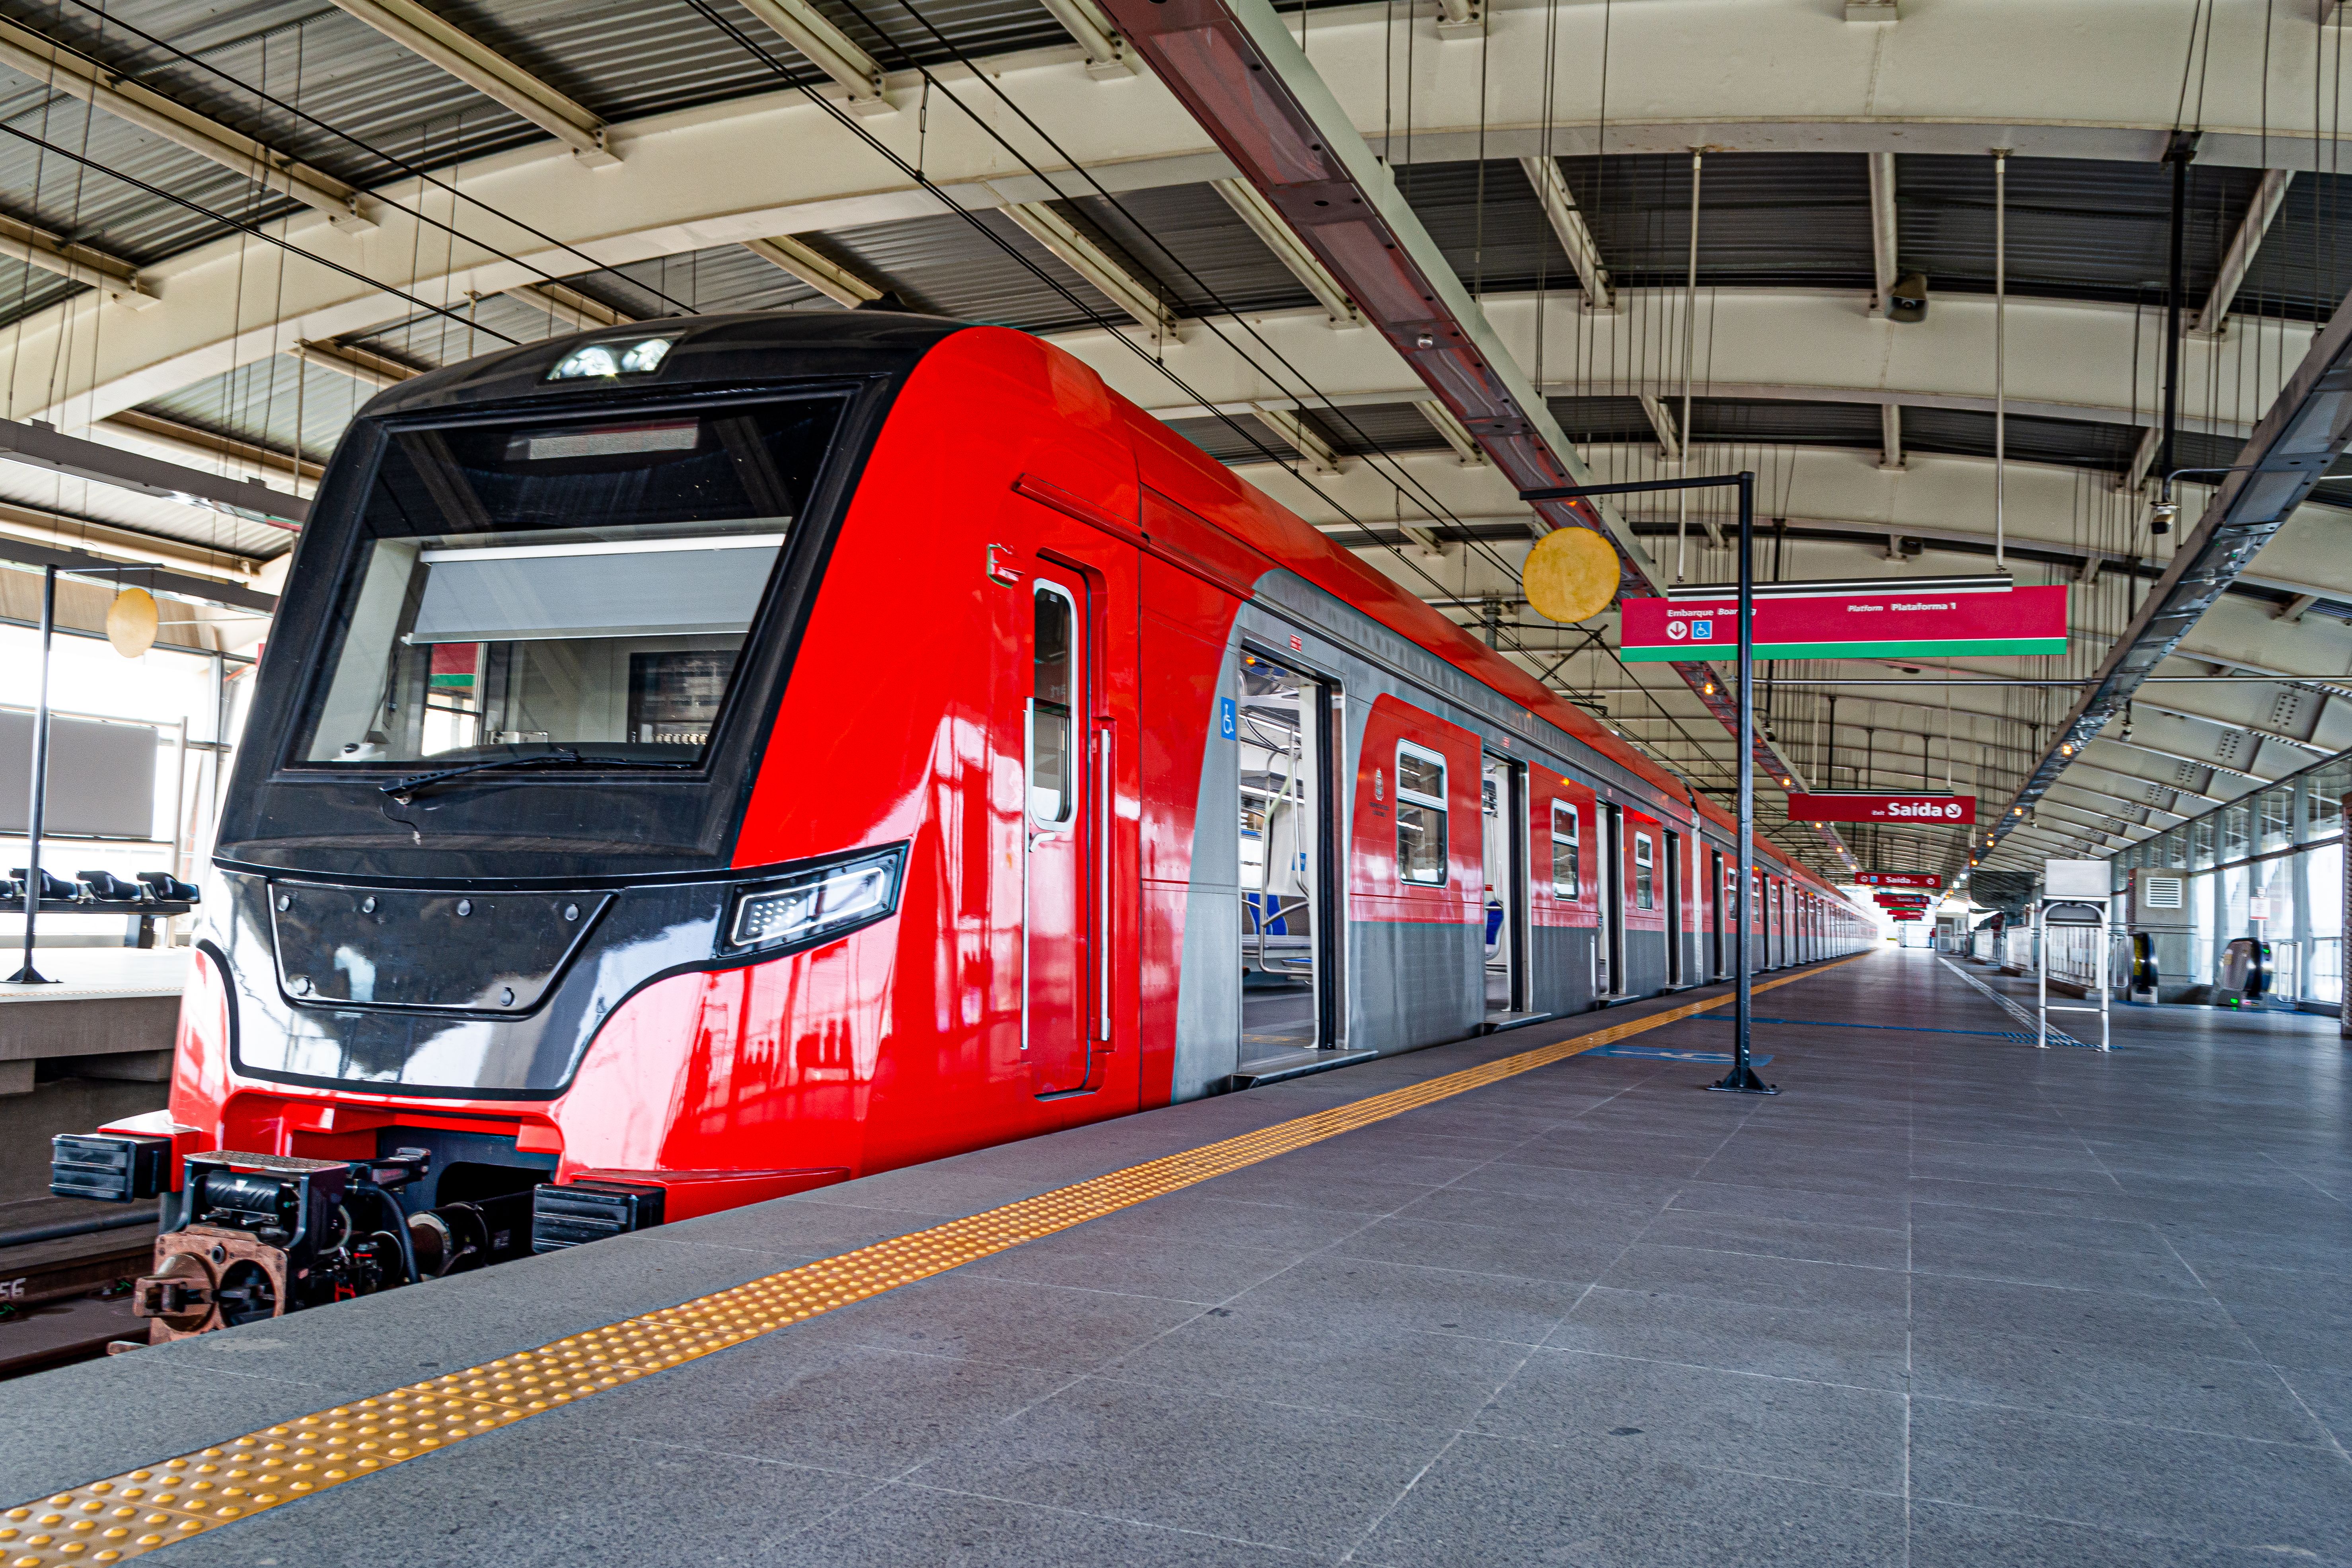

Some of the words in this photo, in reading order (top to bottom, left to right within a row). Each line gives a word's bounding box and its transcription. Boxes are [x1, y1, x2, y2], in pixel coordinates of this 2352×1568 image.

[1891, 602, 1948, 611] Plataforma
[1667, 609, 1714, 617] Embarque
[1887, 802, 1943, 816] Saída
